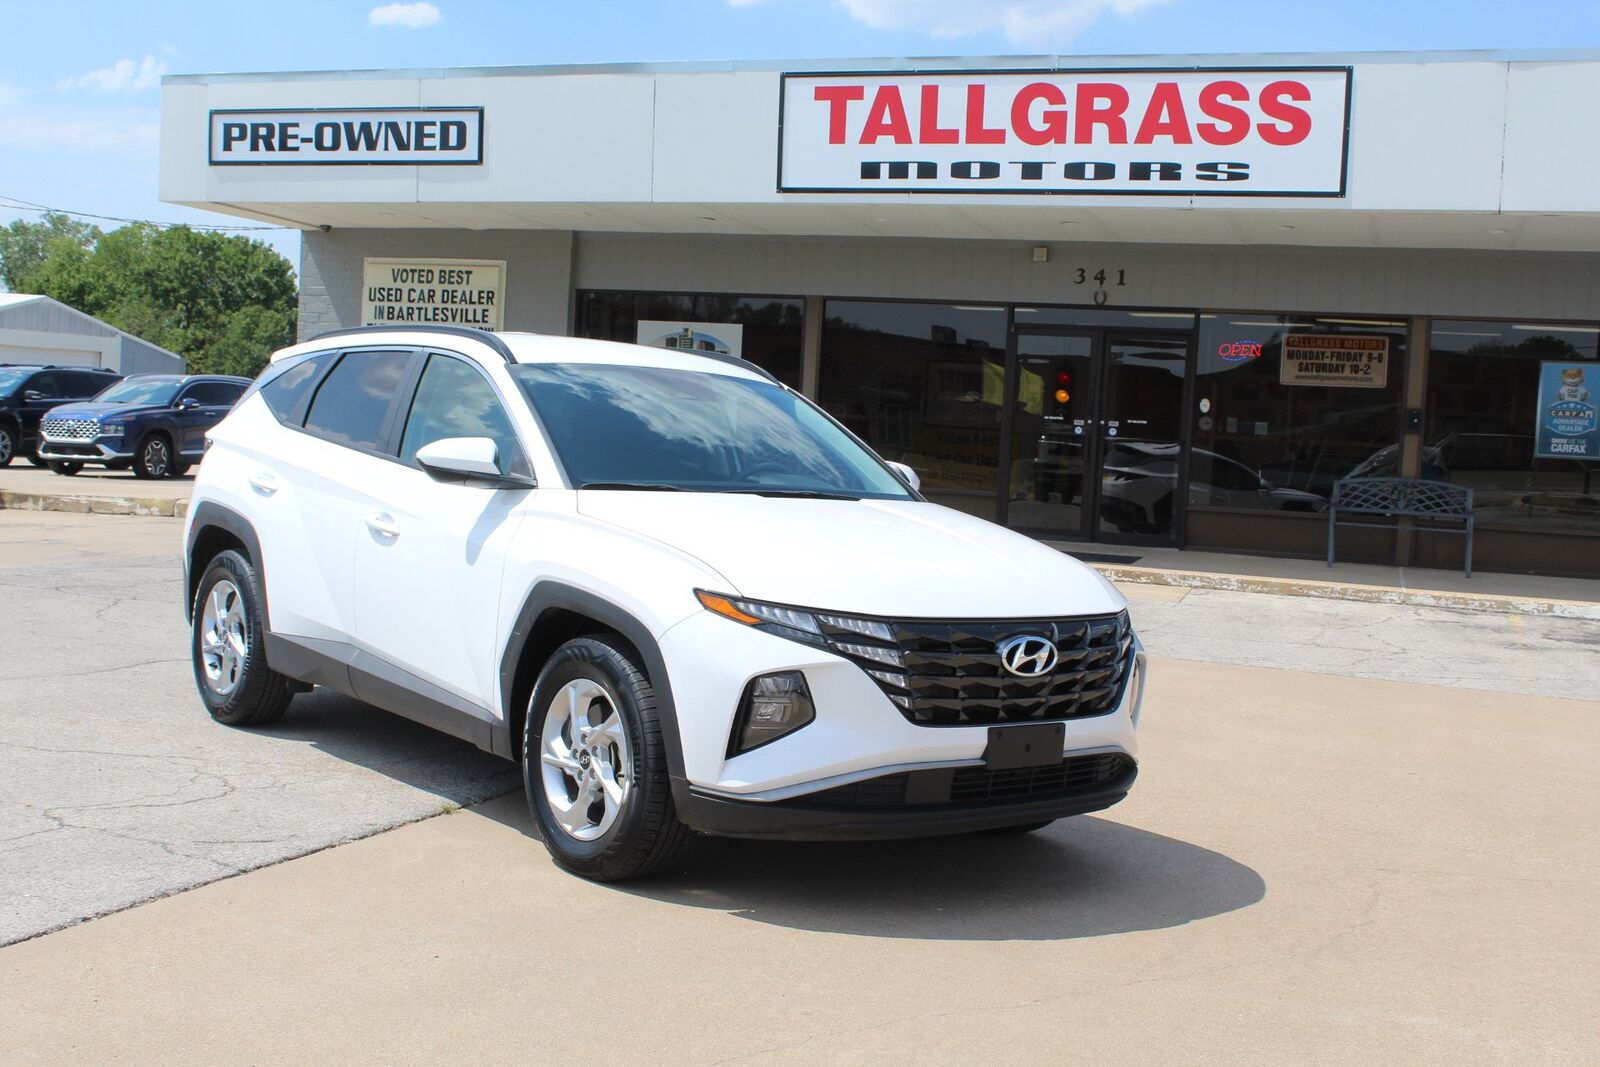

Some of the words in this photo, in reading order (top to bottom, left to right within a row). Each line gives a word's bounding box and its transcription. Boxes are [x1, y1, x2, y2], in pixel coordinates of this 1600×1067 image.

[814, 80, 1312, 146] TALLGRASS
[222, 120, 468, 152] PRE-OWNED
[860, 160, 1251, 182] MOTORS
[391, 268, 435, 284] VOTED
[438, 269, 473, 285] BEST
[1073, 267, 1128, 286] 341
[368, 287, 403, 303] USED
[407, 288, 436, 304] CAR
[441, 289, 495, 306] DEALER
[374, 305, 385, 320] IN
[386, 306, 489, 324] BARTLESVILLE
[1218, 343, 1263, 357] OPEN
[1288, 336, 1341, 348] TALLGRASS
[1344, 339, 1384, 350] MOTORS
[1287, 350, 1364, 363] MONDAY-FRIDAY
[1298, 362, 1346, 374] SATURDAY
[1349, 363, 1371, 376] 10-2
[1552, 418, 1590, 426] ADVANTAGE
[1551, 444, 1586, 454] CARFAX
